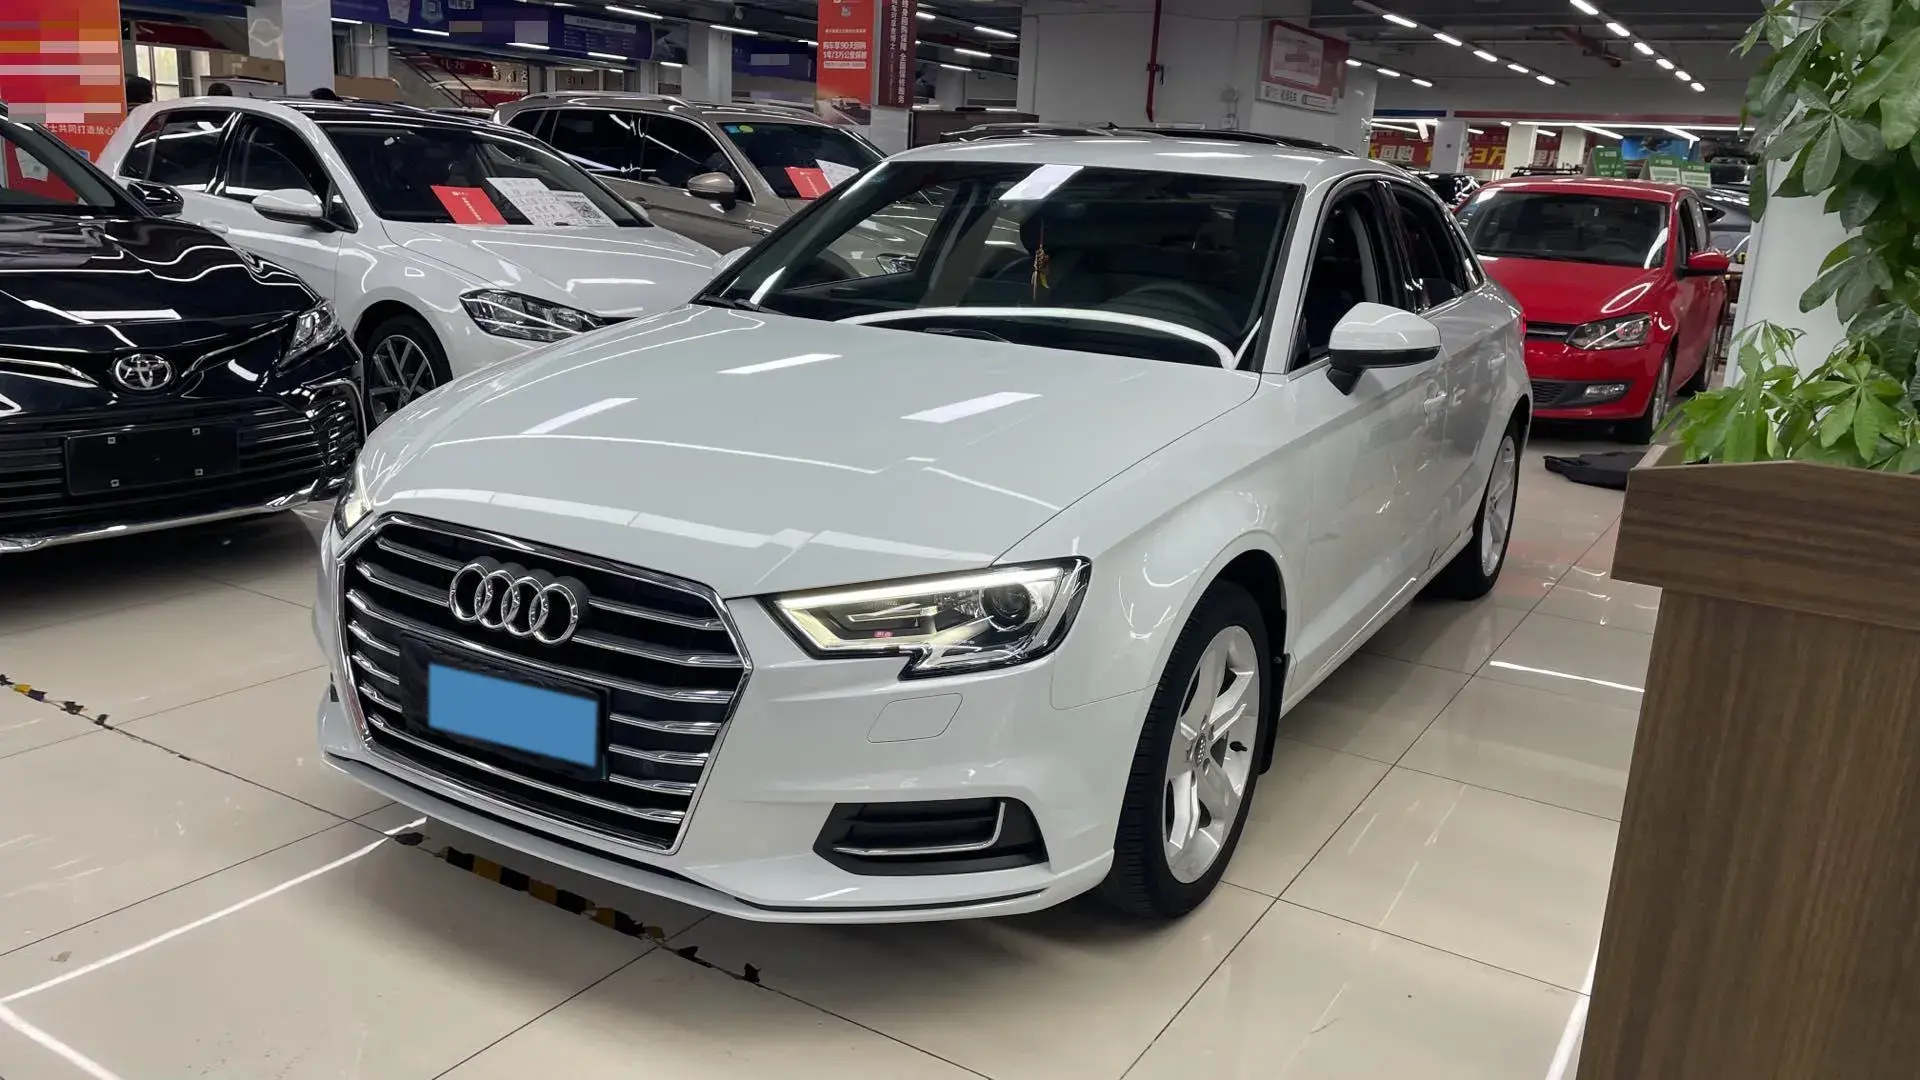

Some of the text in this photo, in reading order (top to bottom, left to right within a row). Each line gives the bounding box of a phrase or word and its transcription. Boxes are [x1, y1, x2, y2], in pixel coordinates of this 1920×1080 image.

[44, 124, 118, 136] 士共同打造放心
[1465, 146, 1506, 164] 3万
